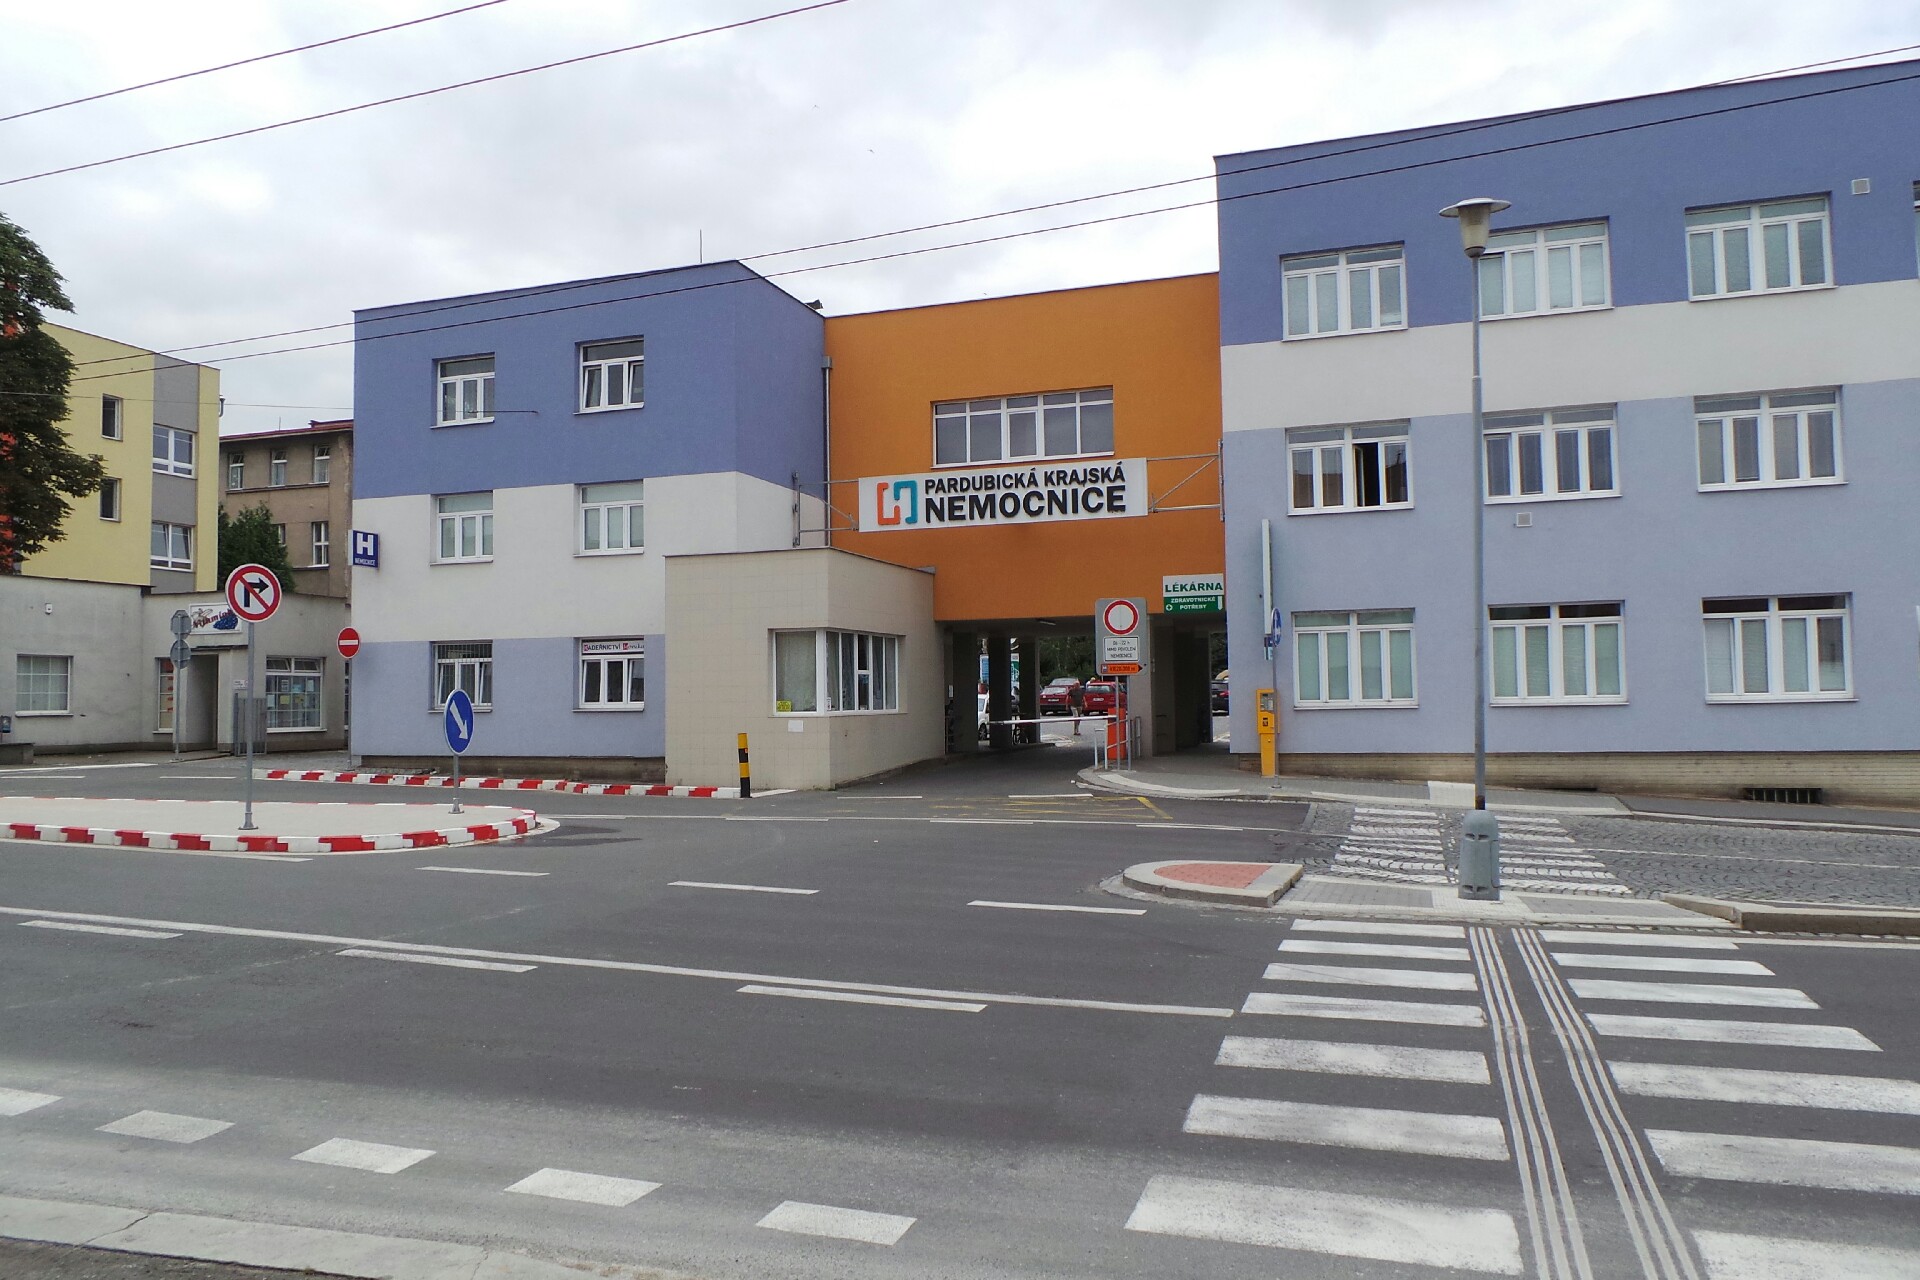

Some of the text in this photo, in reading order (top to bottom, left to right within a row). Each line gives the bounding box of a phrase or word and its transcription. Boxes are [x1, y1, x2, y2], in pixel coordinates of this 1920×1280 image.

[925, 461, 1126, 494] PARDUBICKÁ KRAJSKÁ
[925, 485, 1127, 523] NEMOCNICE
[356, 533, 374, 556] H
[1164, 581, 1223, 593] LÉKÁRNA
[1170, 596, 1216, 604] ZDRAVOTNICKÉ
